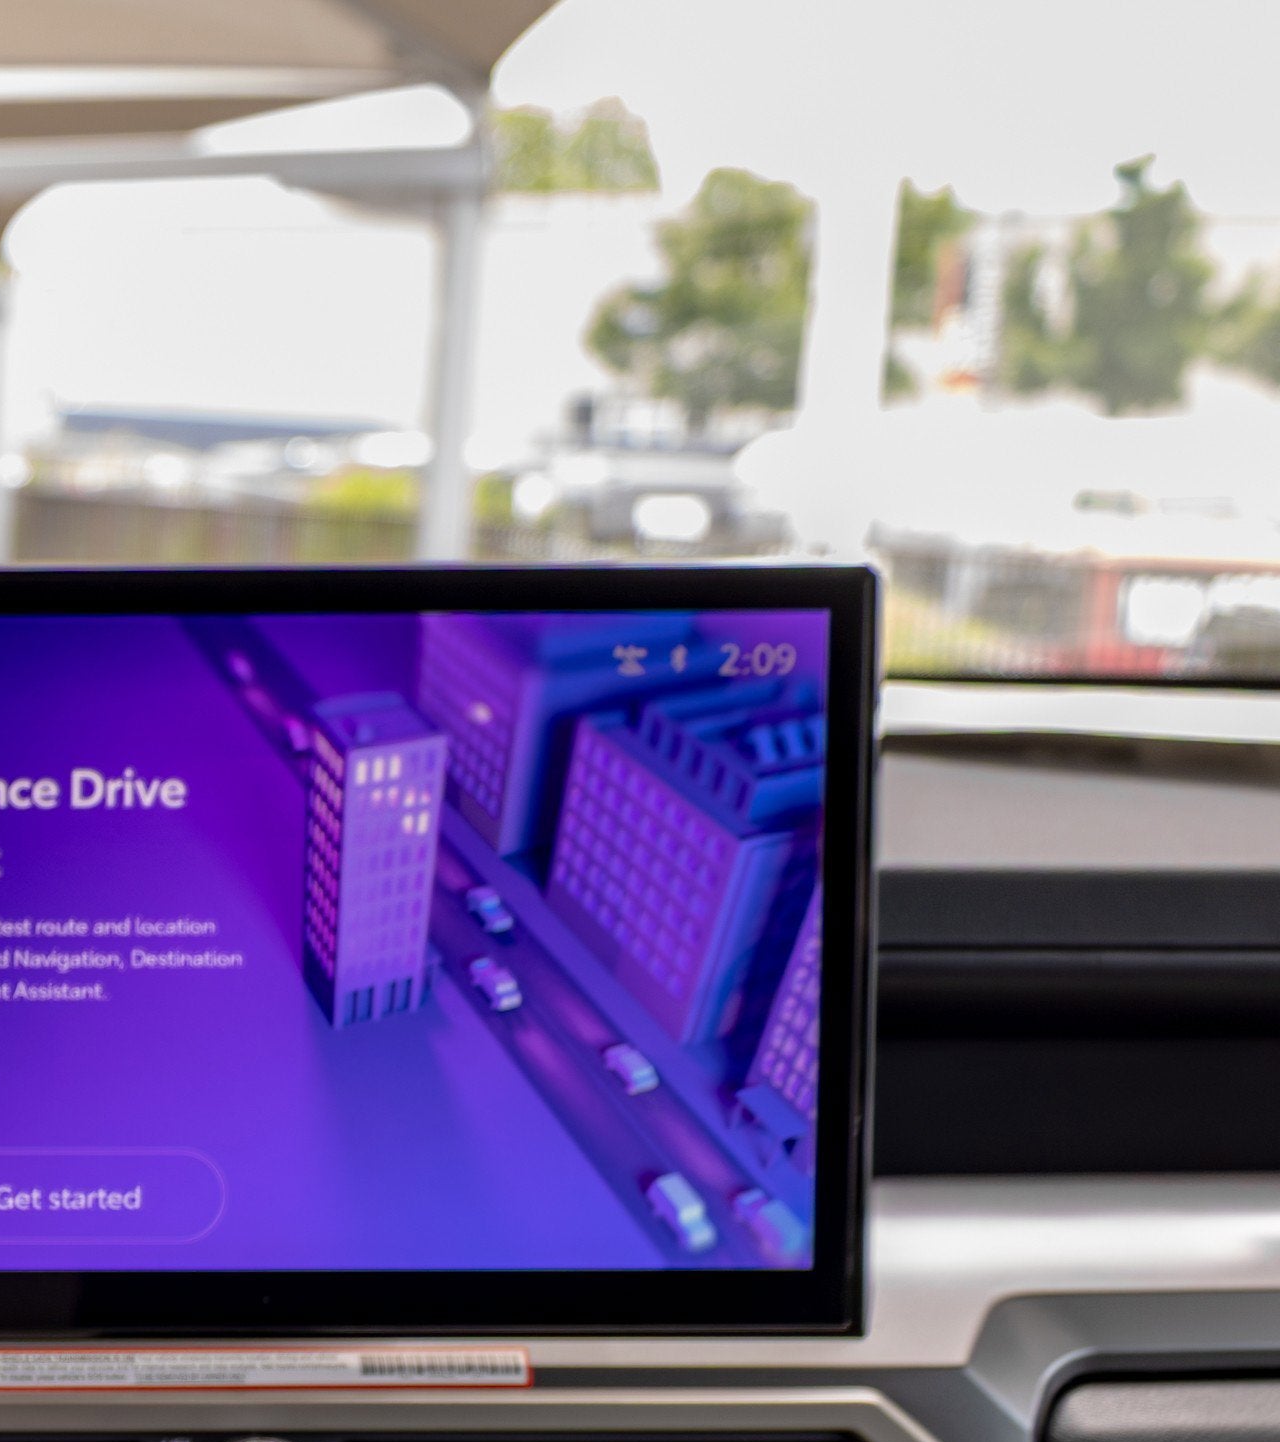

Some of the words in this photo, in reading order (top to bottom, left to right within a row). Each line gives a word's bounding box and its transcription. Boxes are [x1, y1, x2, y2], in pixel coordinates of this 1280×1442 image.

[718, 642, 797, 677] 2:09
[70, 766, 187, 809] Drive
[35, 918, 89, 937] route
[93, 916, 130, 937] and
[134, 916, 216, 937] location
[13, 948, 125, 974] Navigation,
[130, 948, 244, 969] Destination
[12, 980, 108, 1001] Assistant.
[48, 1184, 143, 1211] started
